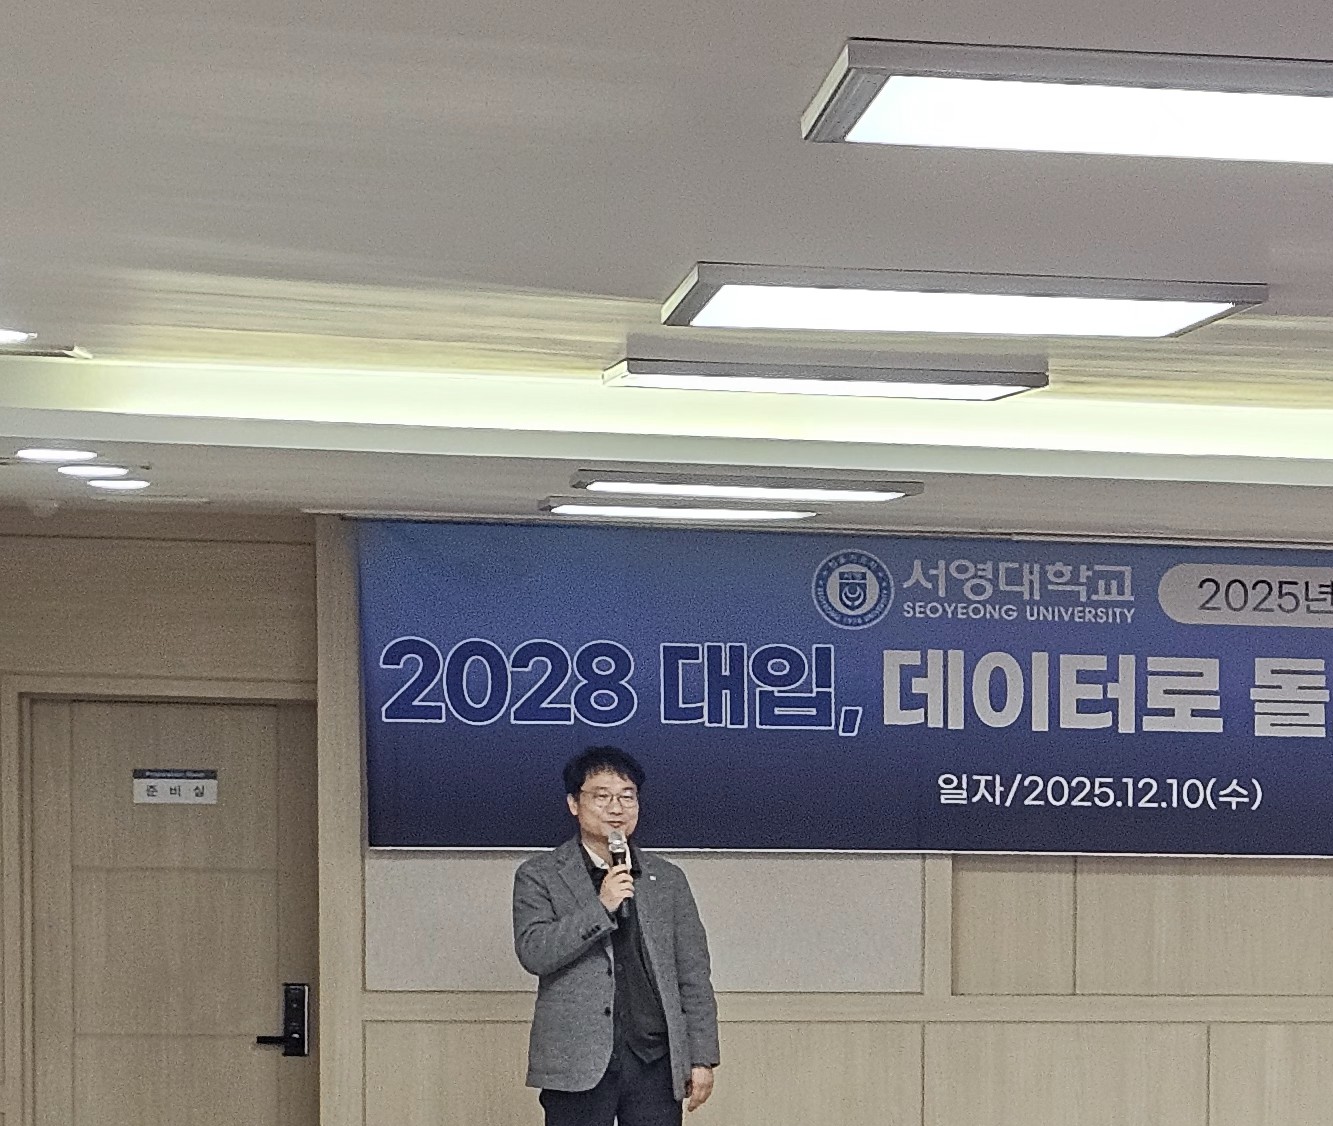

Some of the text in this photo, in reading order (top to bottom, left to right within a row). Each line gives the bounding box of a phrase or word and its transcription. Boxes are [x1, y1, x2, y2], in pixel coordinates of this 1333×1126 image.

[903, 559, 1134, 601] 서영대학교
[903, 602, 1135, 624] SEOYEONG UNIVERSITY
[380, 636, 635, 726] 2028
[660, 643, 863, 736] 대입,
[883, 649, 1224, 734] 데이터로
[937, 773, 1263, 810] 일자/2025.12.10(수)
